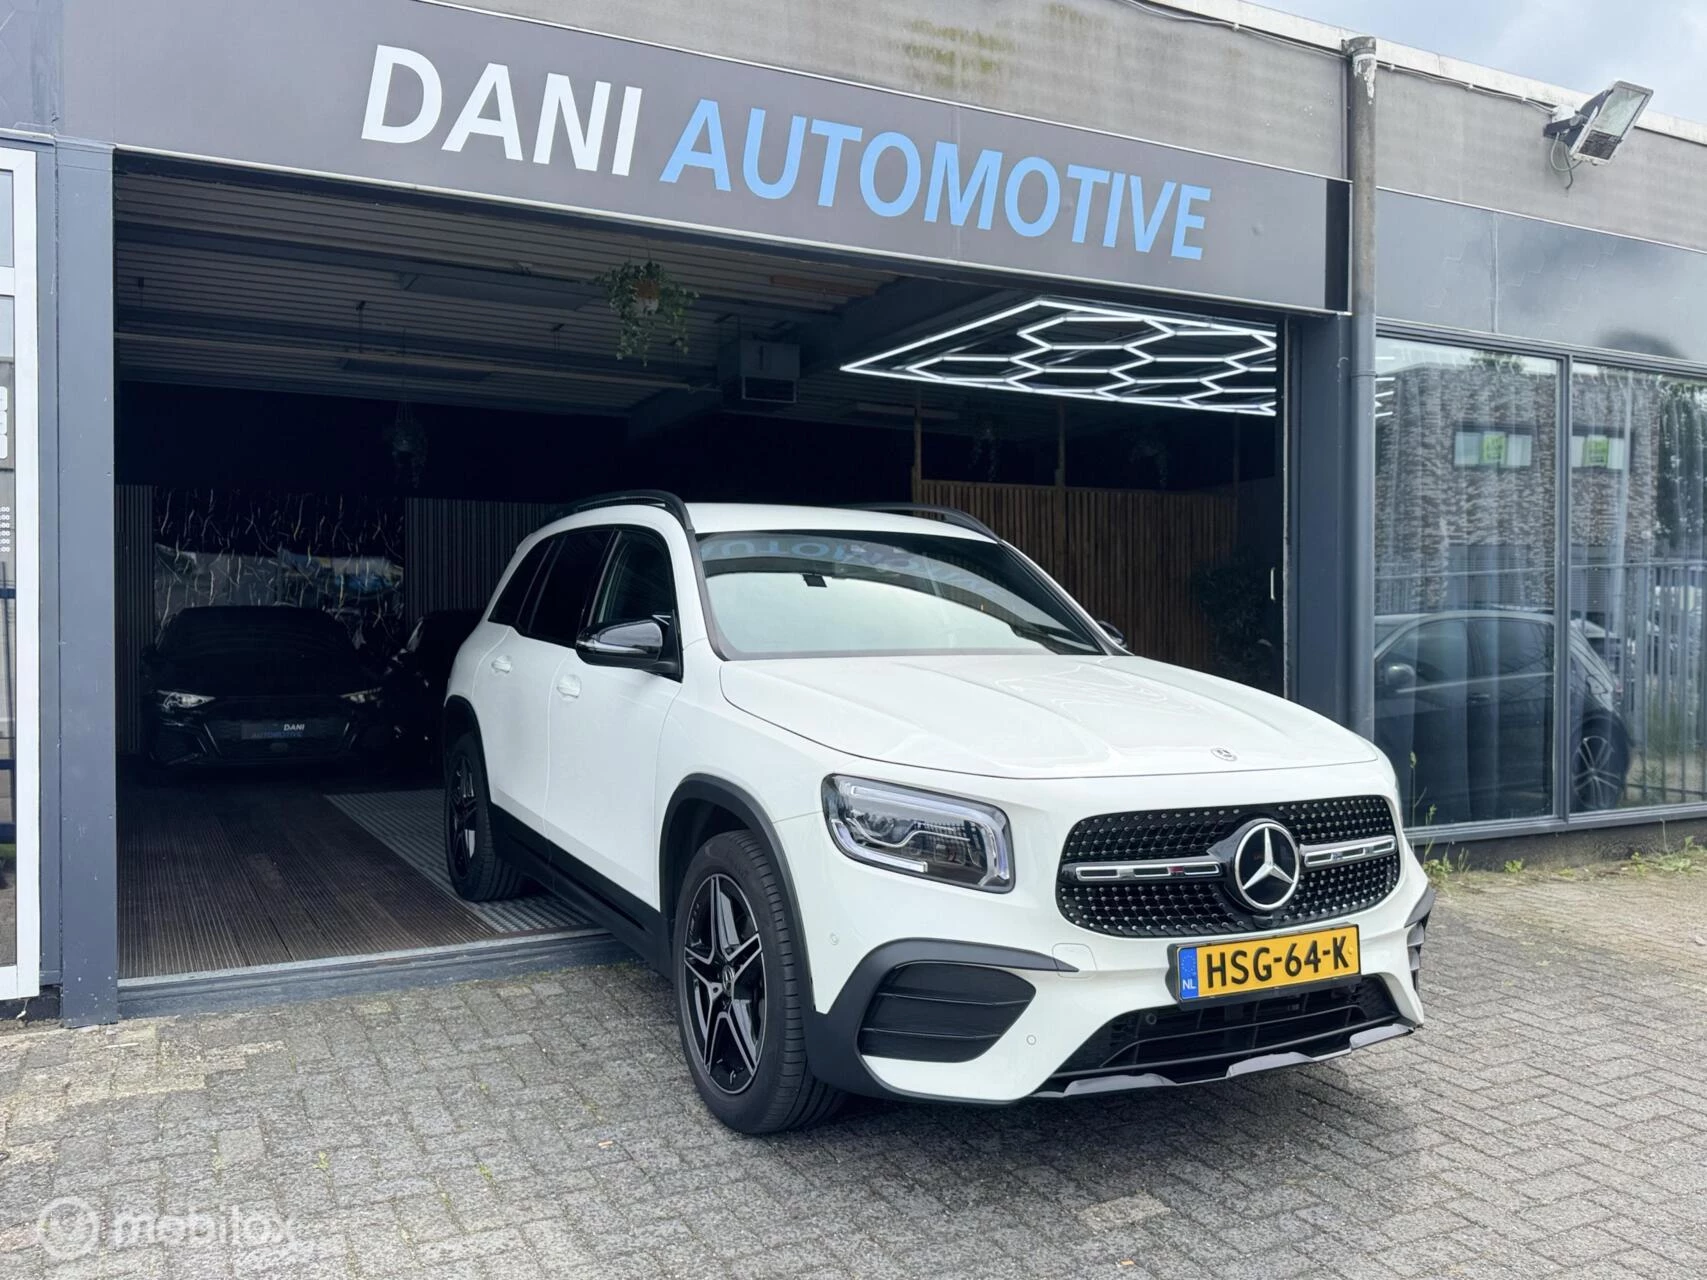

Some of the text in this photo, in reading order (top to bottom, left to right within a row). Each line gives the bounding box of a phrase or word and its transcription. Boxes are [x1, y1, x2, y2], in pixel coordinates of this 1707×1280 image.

[361, 44, 1212, 261] DANI AUTOMOTIVE
[283, 723, 305, 731] DANI
[1182, 937, 1349, 990] NL HSG-64-K
